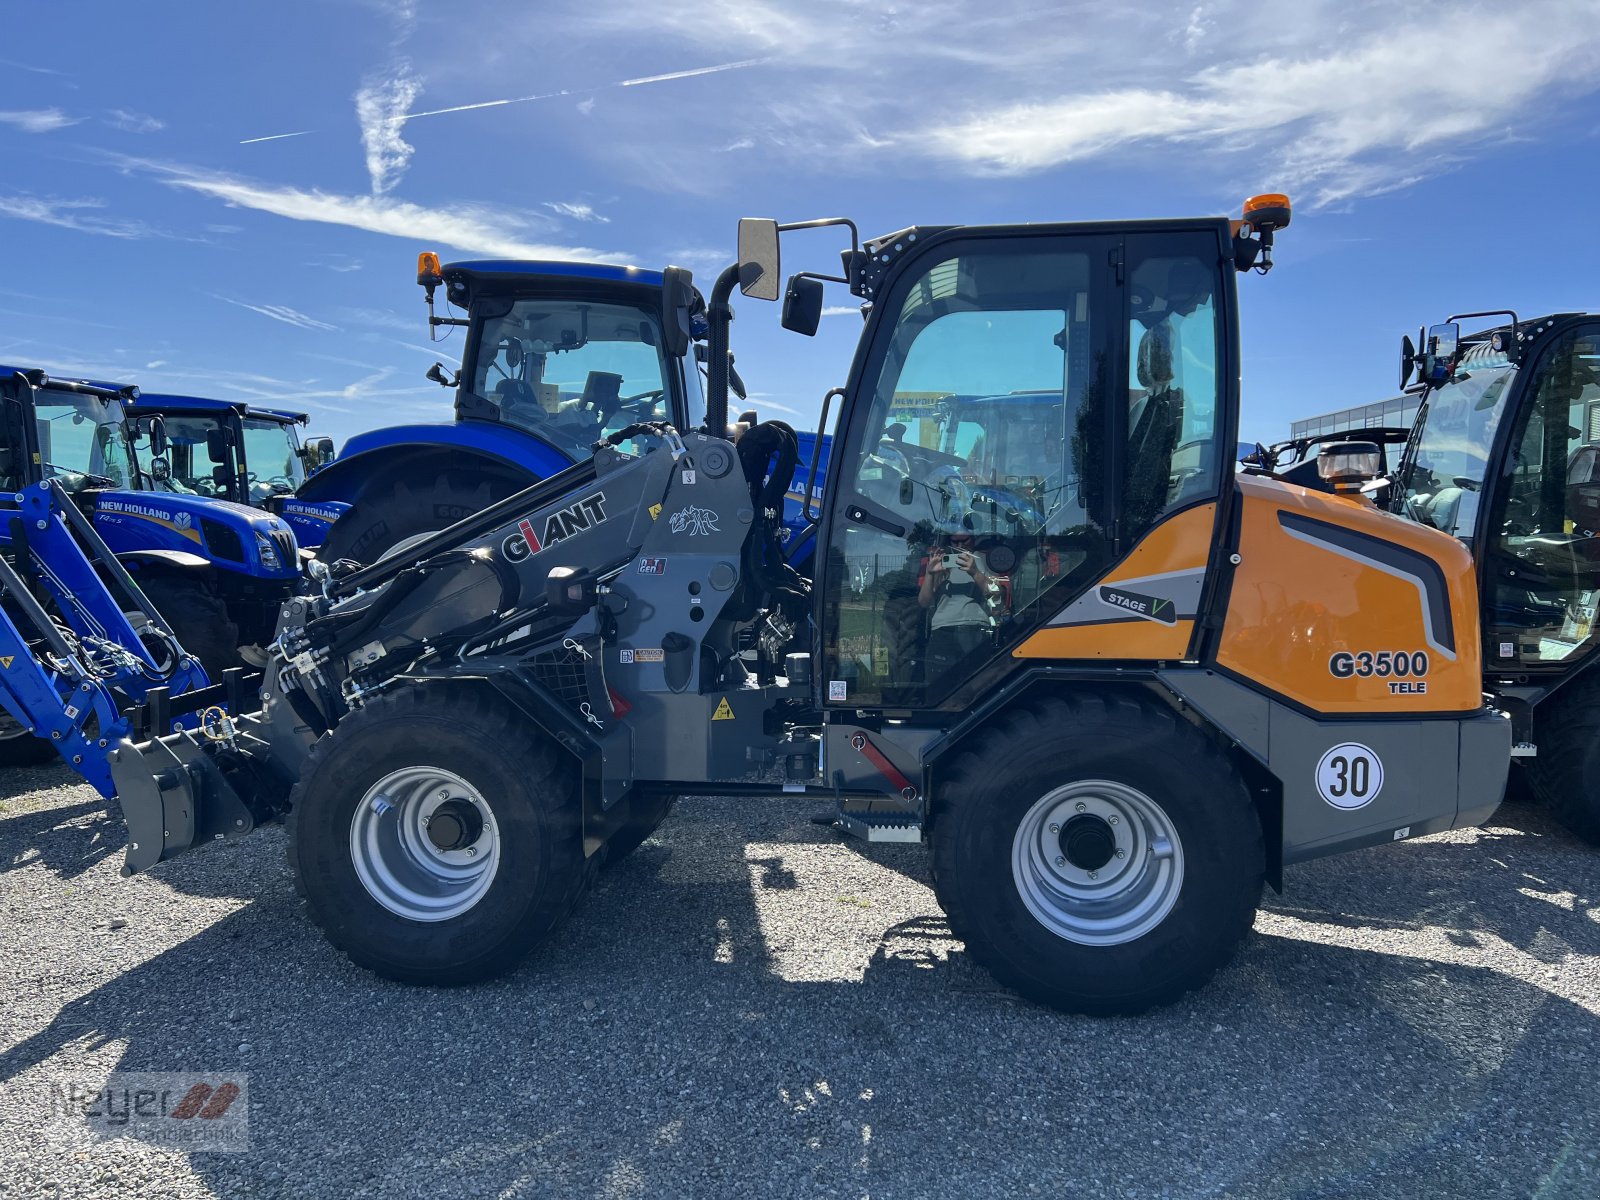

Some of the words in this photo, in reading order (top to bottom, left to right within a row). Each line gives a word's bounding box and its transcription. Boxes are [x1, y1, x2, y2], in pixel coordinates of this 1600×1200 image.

[101, 501, 123, 511] NEW
[124, 503, 171, 521] HOLLAND
[286, 504, 304, 513] NEW
[304, 506, 340, 520] HOLLAND
[1108, 593, 1147, 612] STAGE
[1152, 598, 1172, 615] V
[1328, 651, 1429, 679] G3500
[1387, 681, 1427, 694] TELE
[1329, 755, 1369, 797] 30
